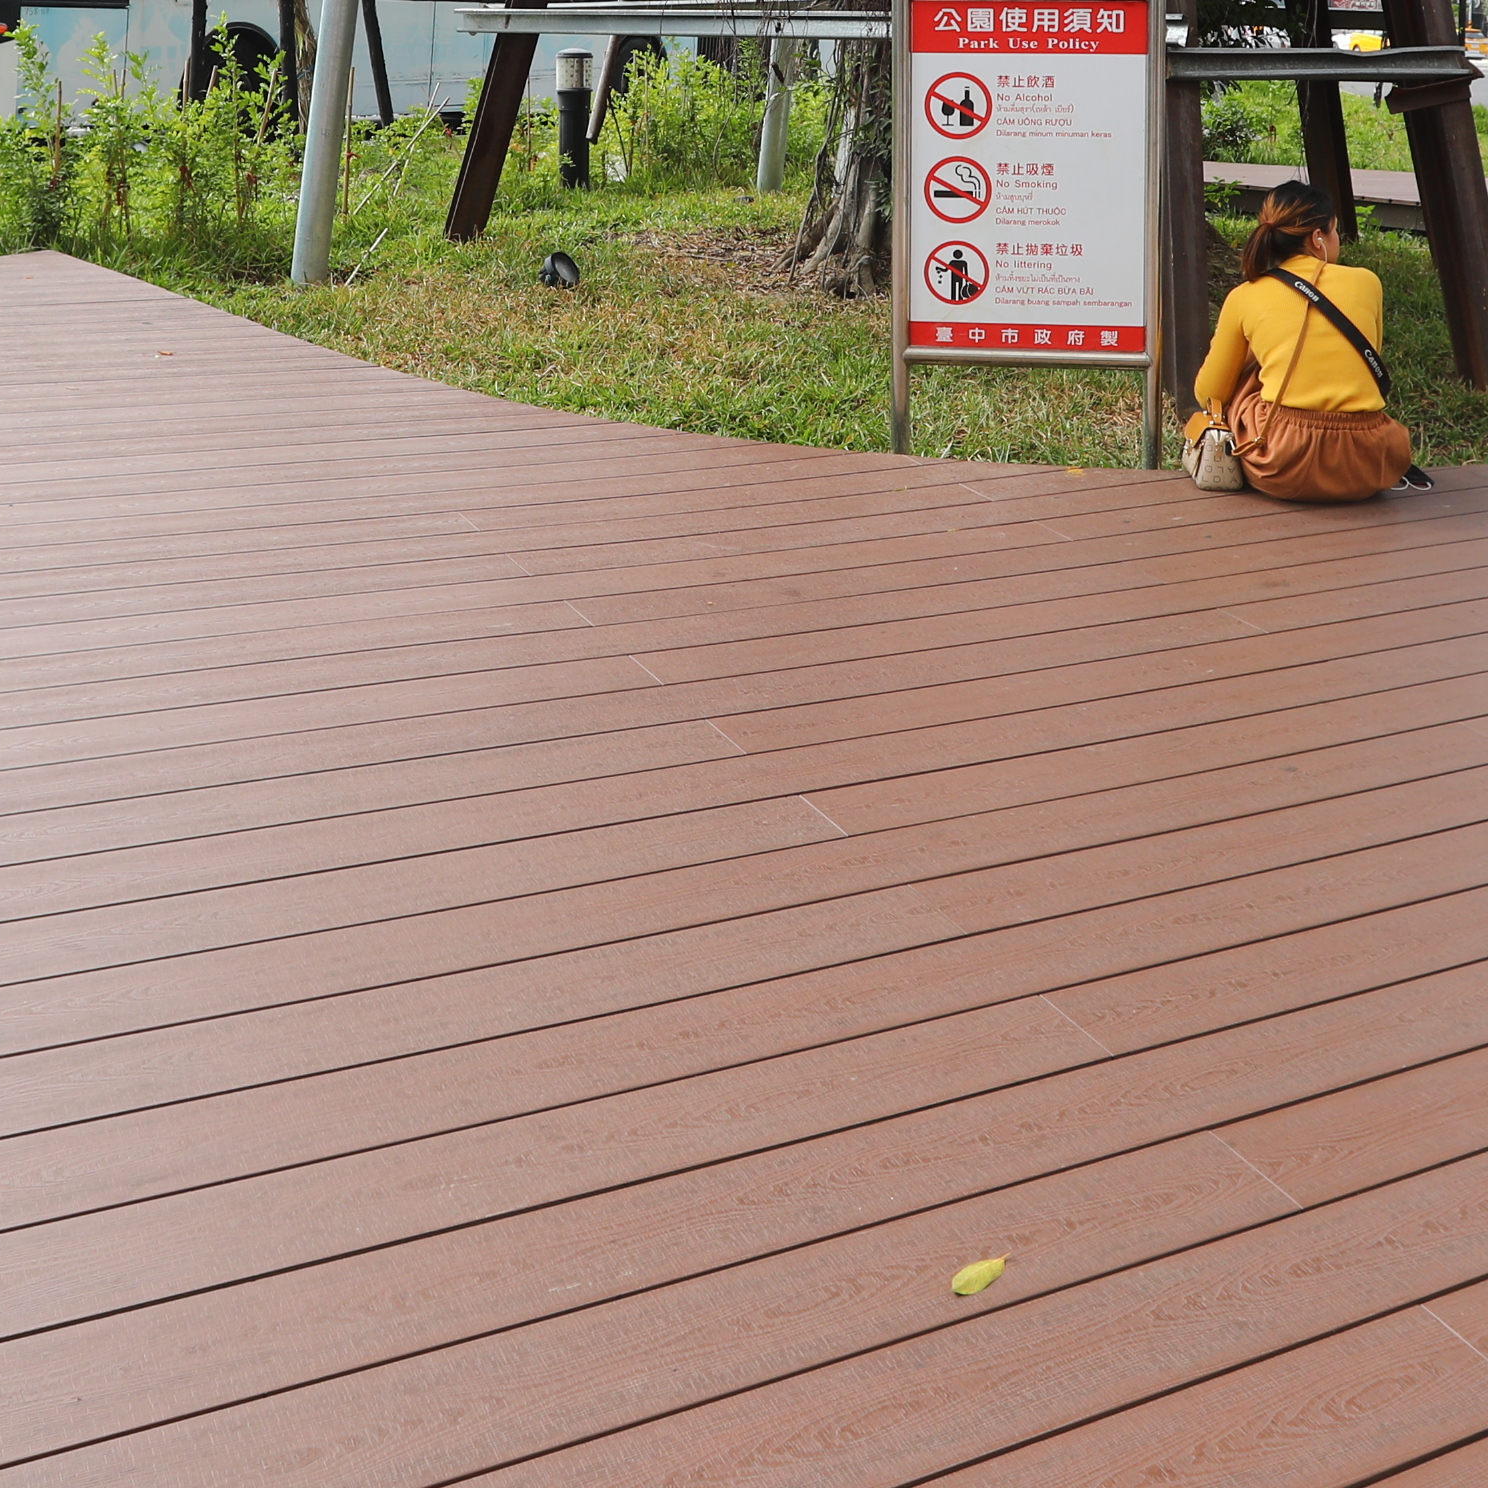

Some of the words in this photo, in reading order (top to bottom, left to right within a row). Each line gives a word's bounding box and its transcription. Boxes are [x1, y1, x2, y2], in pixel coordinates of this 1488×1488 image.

[933, 7, 1125, 34] 公園使用須知
[958, 37, 1000, 49] Park
[1008, 38, 1038, 49] Use
[1047, 38, 1100, 52] Policy
[996, 75, 1056, 89] 禁止飲酒
[996, 93, 1011, 102] No
[1014, 93, 1053, 102] Alcohol
[996, 129, 1027, 139] Dilarang
[1028, 130, 1053, 138] minum
[1055, 130, 1089, 138] minuman
[1090, 130, 1112, 138] keras
[996, 162, 1055, 176] 禁止吸煙
[996, 180, 1010, 189] No
[1014, 180, 1058, 190] Smoking
[995, 217, 1027, 227] Dilarang
[1028, 218, 1061, 226] merokok
[996, 260, 1010, 269] No
[1037, 285, 1056, 296] RÁC
[995, 297, 1026, 307] Dilarang
[1027, 298, 1050, 308] buang
[1052, 298, 1081, 308] sampah
[1083, 299, 1133, 309] sembarangan
[935, 326, 1119, 347] 臺中市政府製
